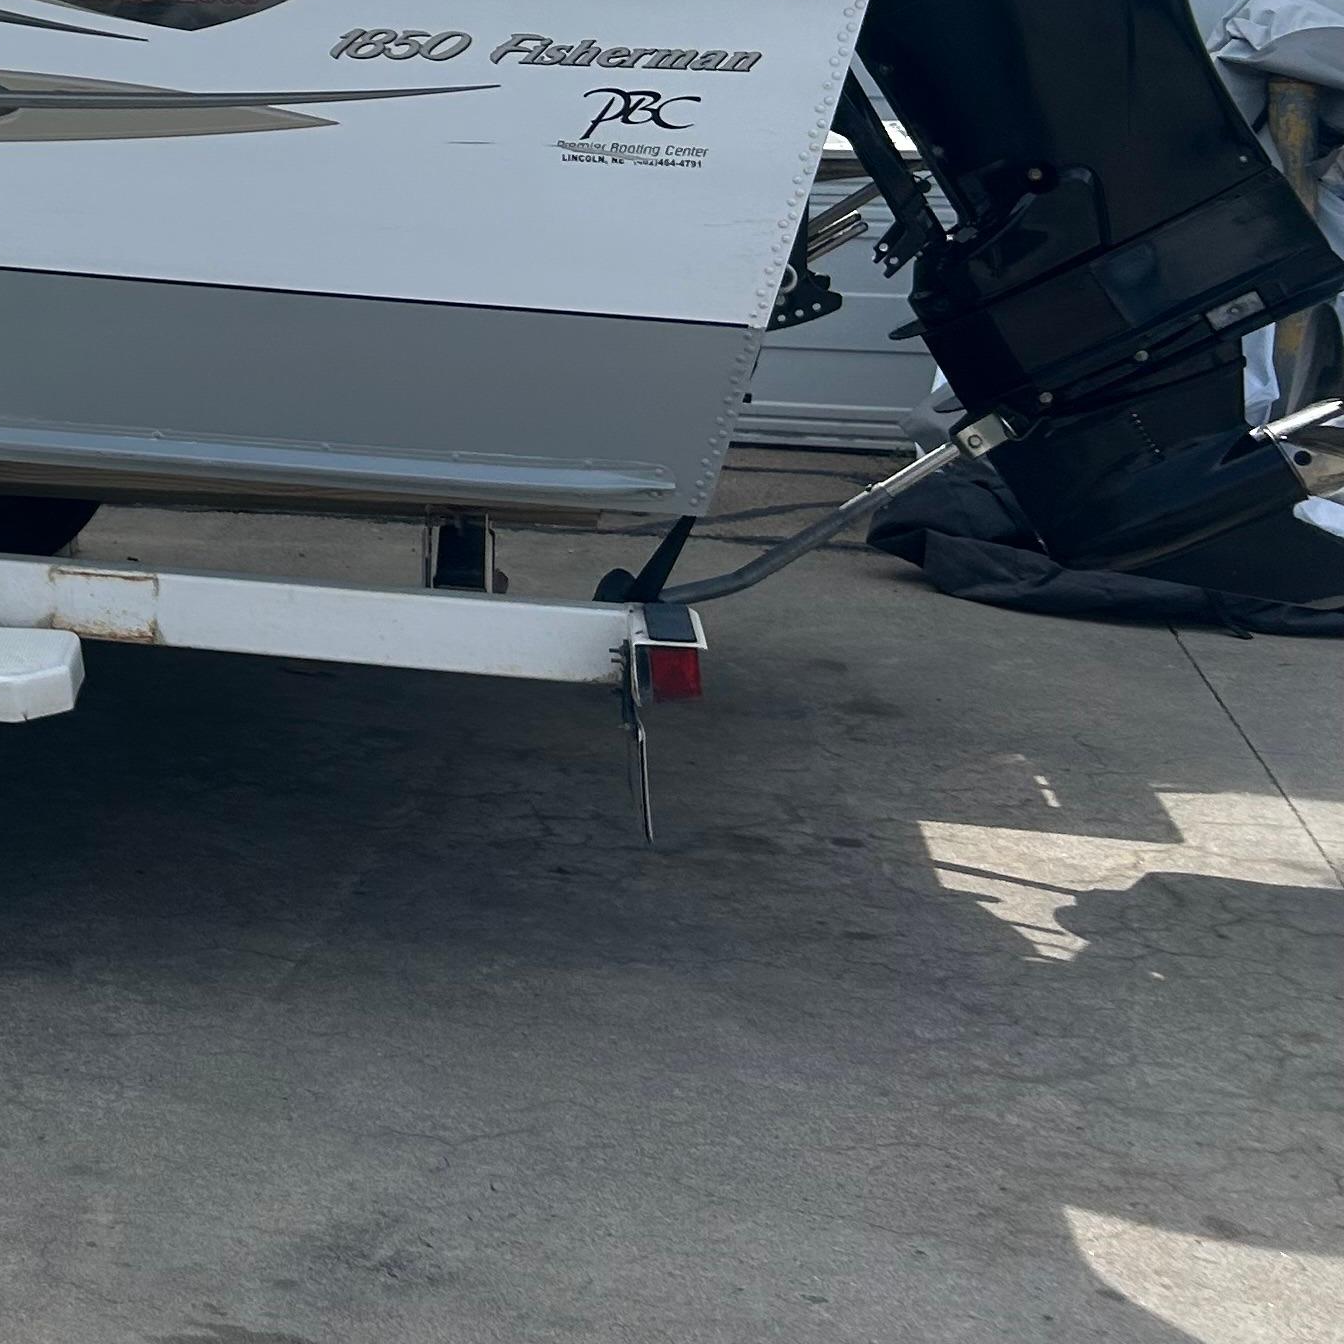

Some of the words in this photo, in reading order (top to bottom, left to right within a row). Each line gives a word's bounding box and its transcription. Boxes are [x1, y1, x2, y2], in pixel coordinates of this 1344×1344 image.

[329, 27, 473, 62] 1850
[489, 33, 763, 73] Fisherman
[580, 88, 702, 140] PBC
[609, 142, 661, 157] Boating
[665, 144, 709, 158] Center
